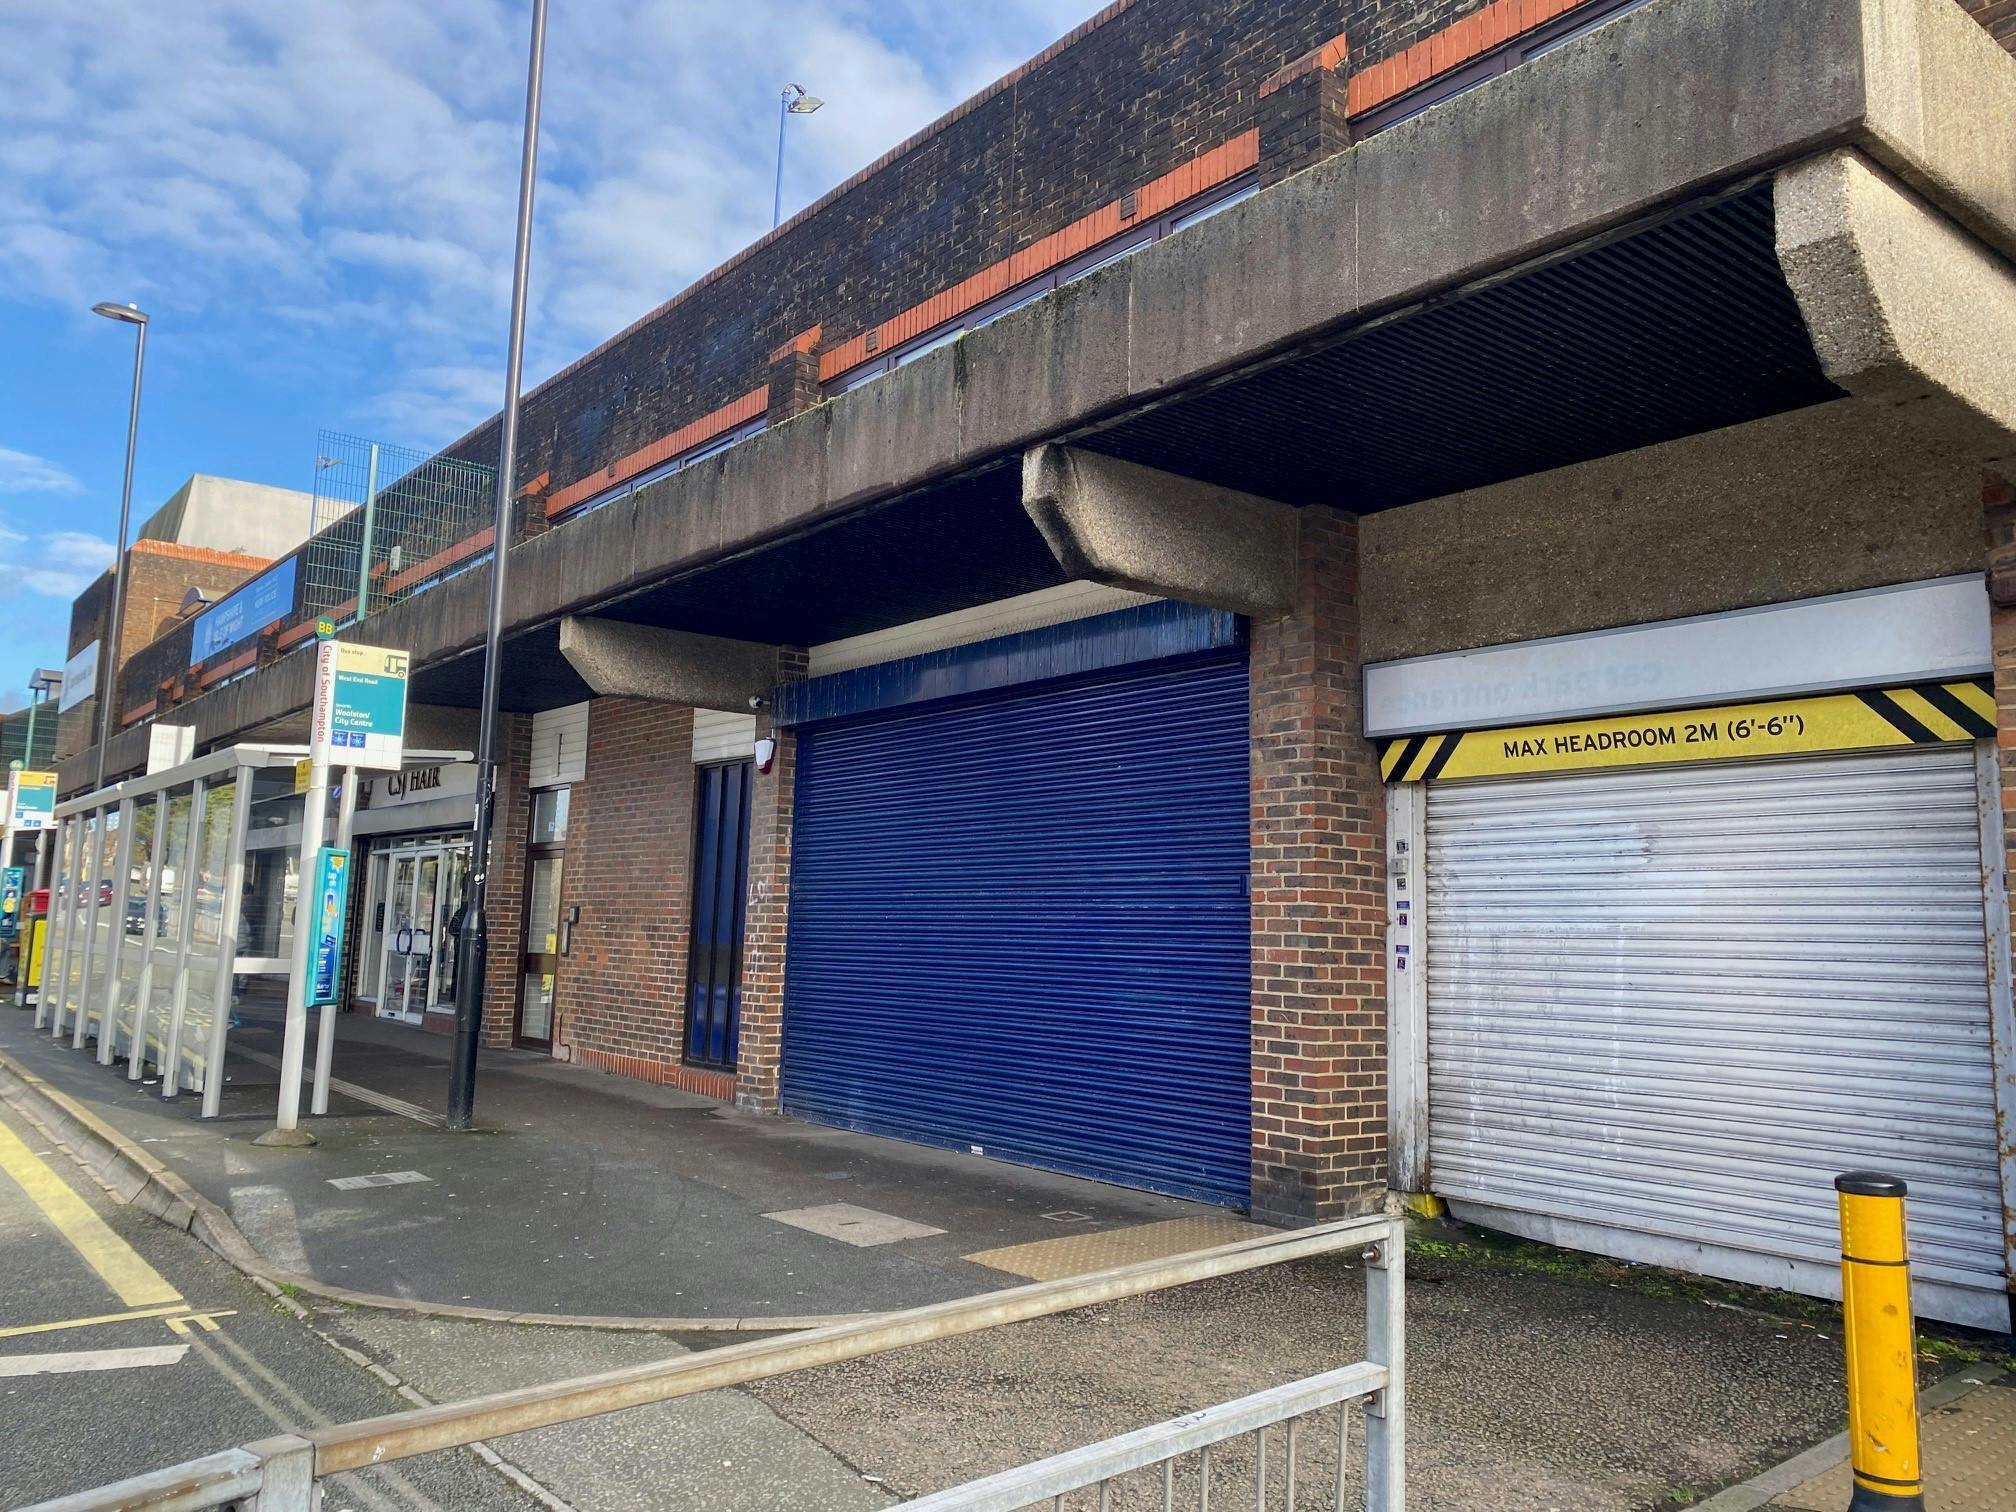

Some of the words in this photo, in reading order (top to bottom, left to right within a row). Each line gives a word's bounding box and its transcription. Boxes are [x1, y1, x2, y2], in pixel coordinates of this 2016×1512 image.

[319, 621, 333, 634] BB
[320, 645, 333, 663] City
[322, 666, 331, 676] of
[316, 679, 331, 743] Southampton
[334, 717, 349, 726] City
[350, 718, 373, 727] Centre
[1503, 737, 1548, 759] MAX
[1553, 726, 1677, 755] HEADROOM
[1684, 722, 1719, 744] 2M
[410, 767, 441, 792] HAIR
